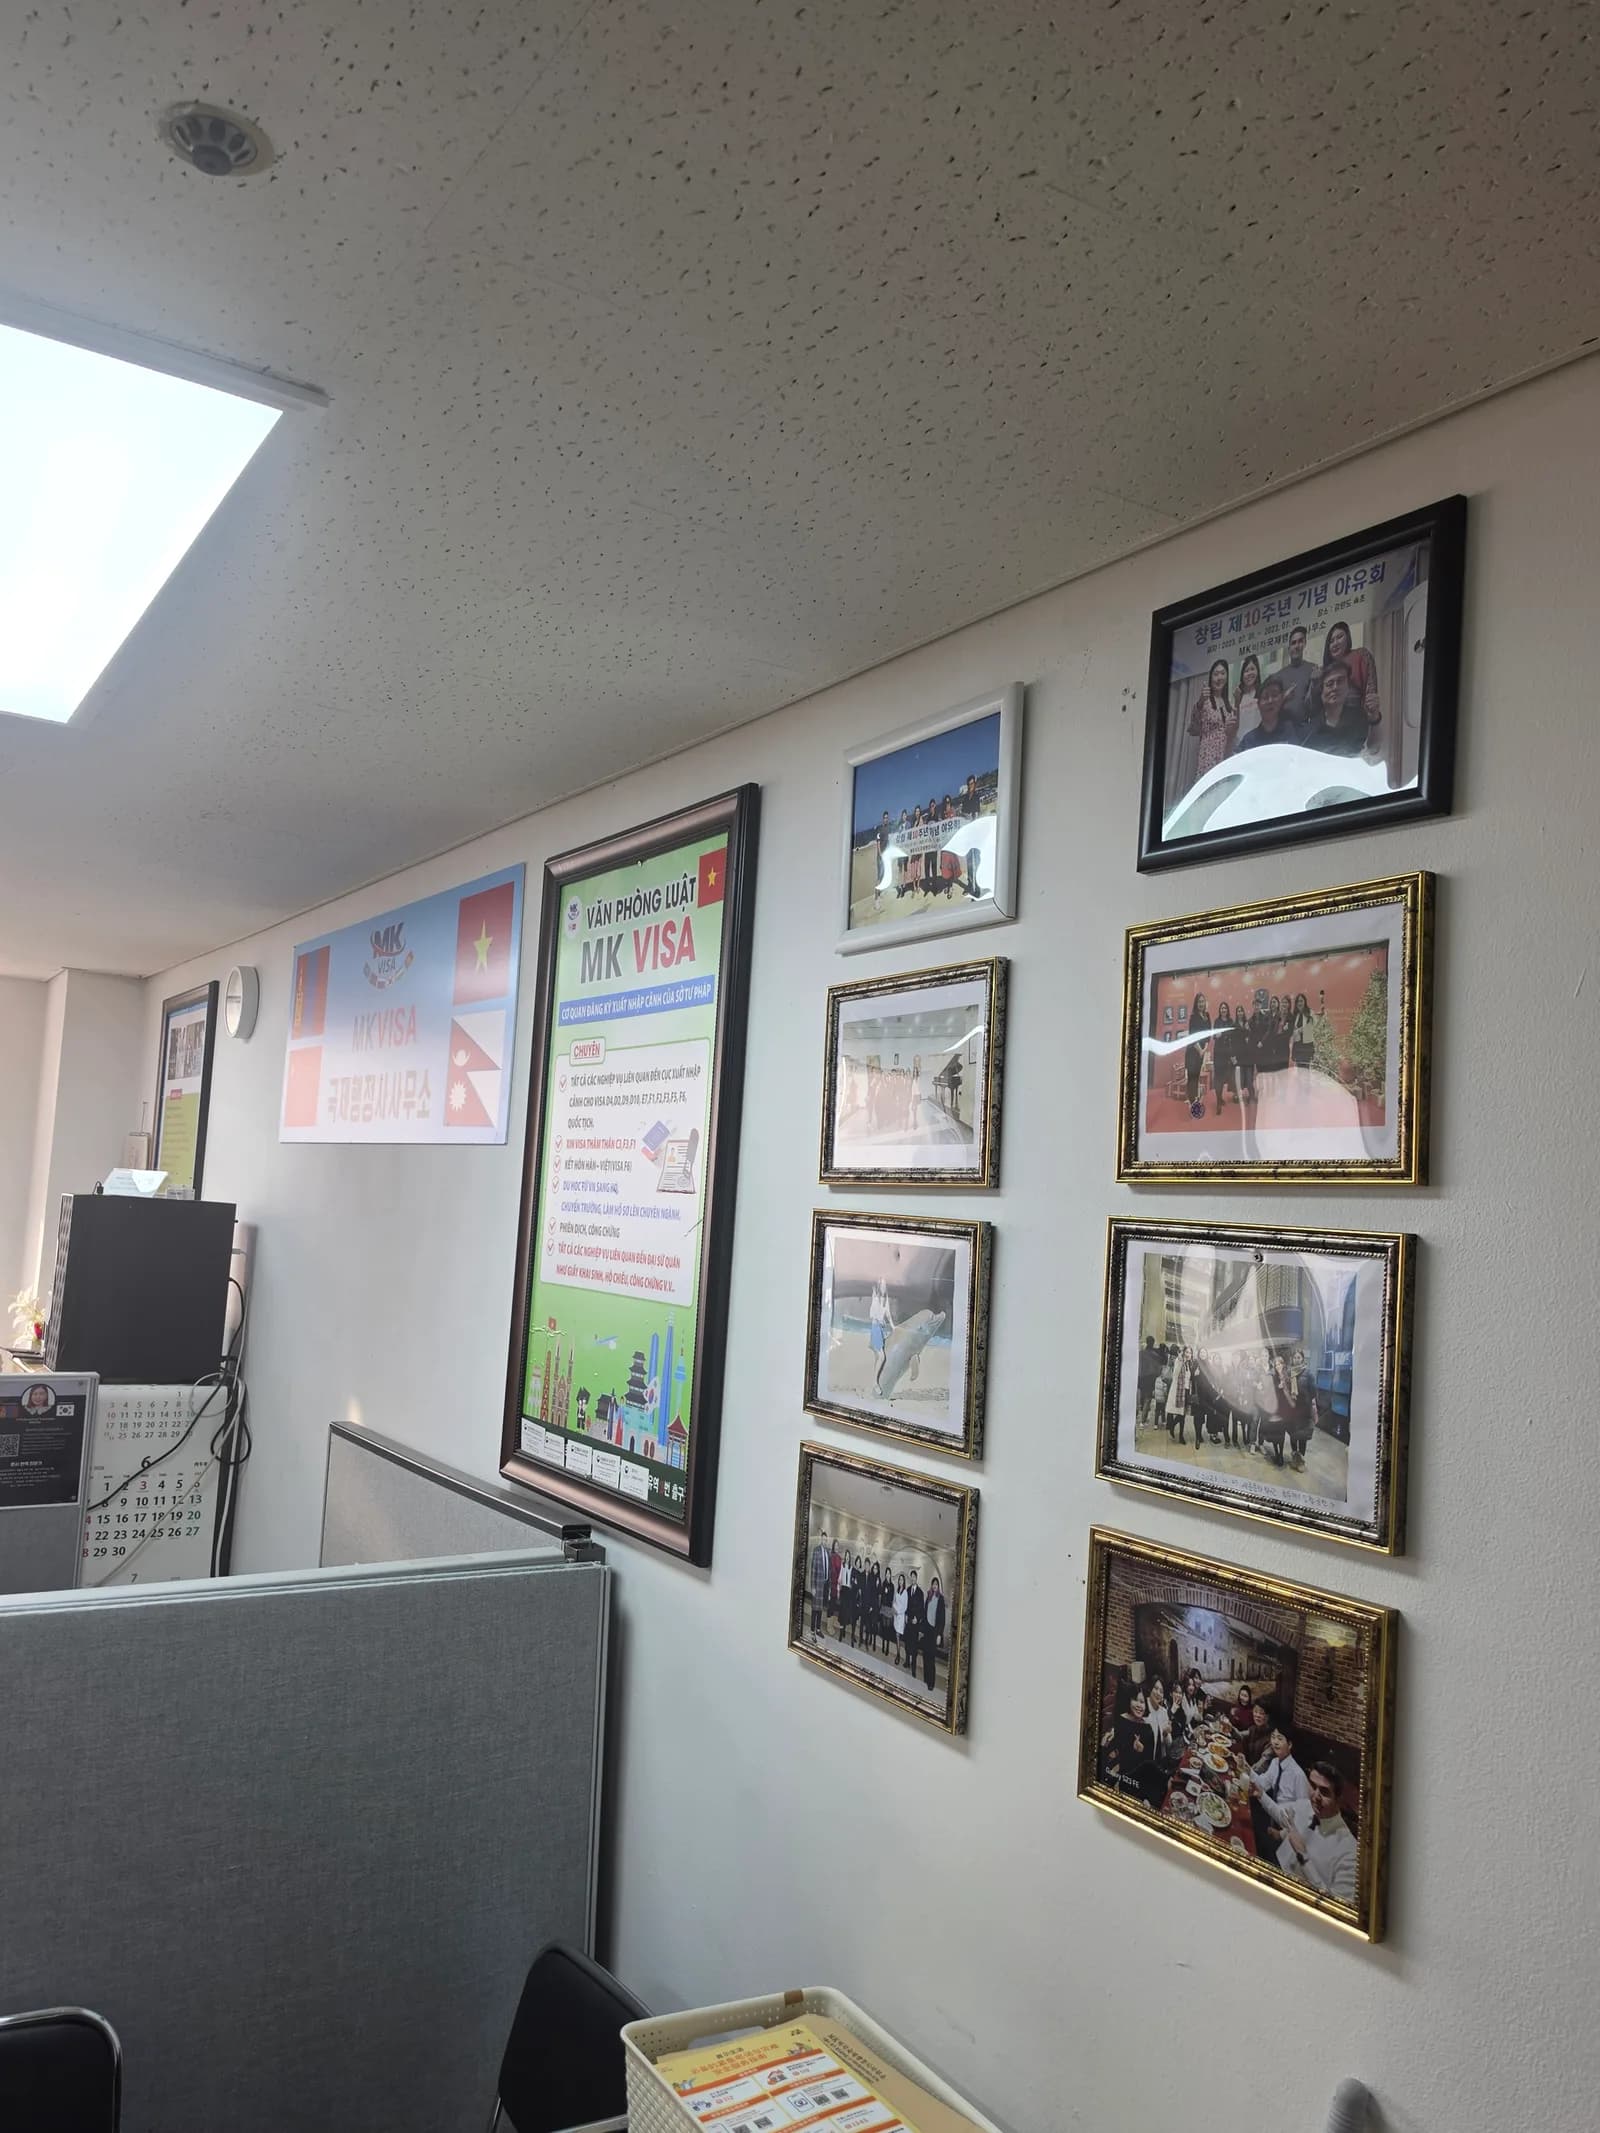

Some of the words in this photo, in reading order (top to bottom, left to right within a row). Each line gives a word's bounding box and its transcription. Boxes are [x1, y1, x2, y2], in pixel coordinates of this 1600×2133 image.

[1194, 618, 1222, 646] 창립
[1229, 596, 1292, 633] 제10주년
[1297, 582, 1328, 609] 기념
[1335, 562, 1386, 596] 야유회
[587, 899, 613, 929] VĂN
[615, 887, 662, 923] PHÒNG
[665, 872, 696, 912] LUẬT
[373, 922, 405, 955] MK
[580, 933, 625, 984] MK
[632, 915, 696, 973] VISA
[377, 957, 397, 975] VISA
[569, 1005, 586, 1019] QUAN
[586, 1001, 603, 1016] ĐĂNG
[627, 994, 644, 1013] NHẬP
[644, 991, 662, 1007] CẢNH
[662, 989, 674, 1005] CỦA
[693, 982, 711, 1000] PHÁP
[573, 1041, 600, 1057] CHUYÊN
[594, 1095, 605, 1106] VISA
[575, 1138, 585, 1148] VISA
[141, 1455, 151, 1468] 6
[104, 1482, 109, 1491] 1
[140, 1480, 147, 1490] 3
[158, 1480, 165, 1489] 4
[176, 1479, 183, 1489] 5
[120, 1497, 127, 1507] 9
[136, 1497, 149, 1506] 10
[153, 1496, 166, 1505] 11
[171, 1495, 184, 1505] 12
[190, 1494, 202, 1504] 13
[97, 1514, 110, 1524] 15
[116, 1514, 129, 1523] 16
[134, 1512, 147, 1523] 17
[152, 1512, 165, 1522] 18
[170, 1511, 183, 1521] 19
[187, 1510, 201, 1520] 20
[95, 1530, 109, 1541] 22
[113, 1529, 127, 1540] 23
[132, 1529, 146, 1539] 24
[150, 1528, 164, 1538] 25
[168, 1527, 182, 1537] 26
[186, 1526, 200, 1536] 27
[93, 1547, 108, 1557] 29
[112, 1546, 126, 1556] 30
